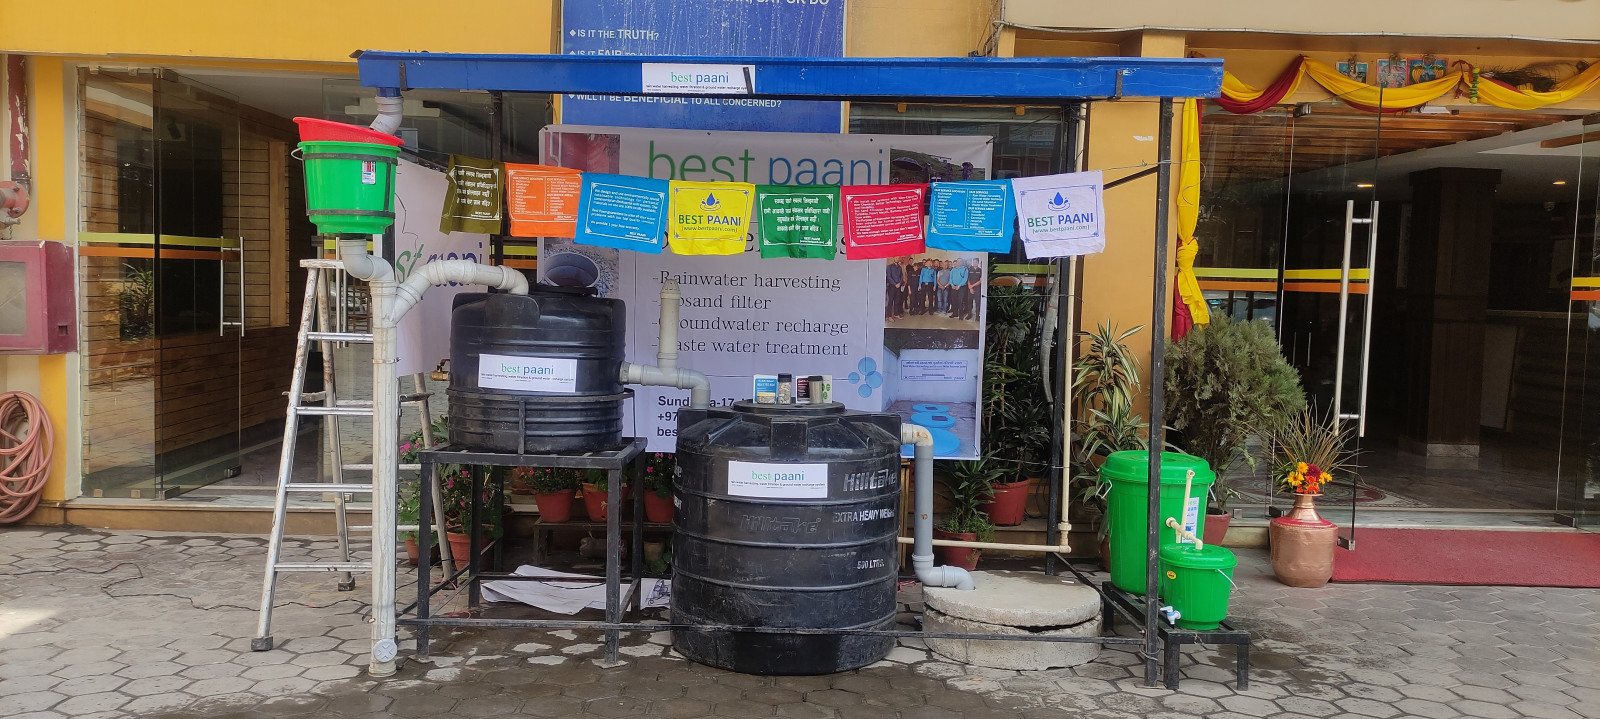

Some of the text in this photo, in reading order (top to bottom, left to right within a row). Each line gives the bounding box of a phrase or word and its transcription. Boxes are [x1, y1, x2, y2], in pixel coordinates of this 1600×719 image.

[598, 30, 616, 38] THE
[617, 29, 659, 40] TRUTH?
[670, 72, 729, 85] best paani
[623, 96, 688, 104] BENEFICIAL
[722, 98, 782, 107] CONCERNED?
[649, 140, 883, 186] best paani
[678, 214, 742, 227] BEST PAANI
[1027, 212, 1094, 228] BEST PAANI
[652, 271, 841, 292] -Rainwater harvesting
[730, 296, 771, 309] filter
[651, 317, 849, 336] -oundwater recharge
[651, 337, 849, 356] -aste water treatment
[501, 363, 554, 376] best paani
[751, 470, 771, 481] best
[774, 470, 804, 483] paani
[833, 512, 858, 522] EXTRA
[859, 509, 879, 521] HEAVY
